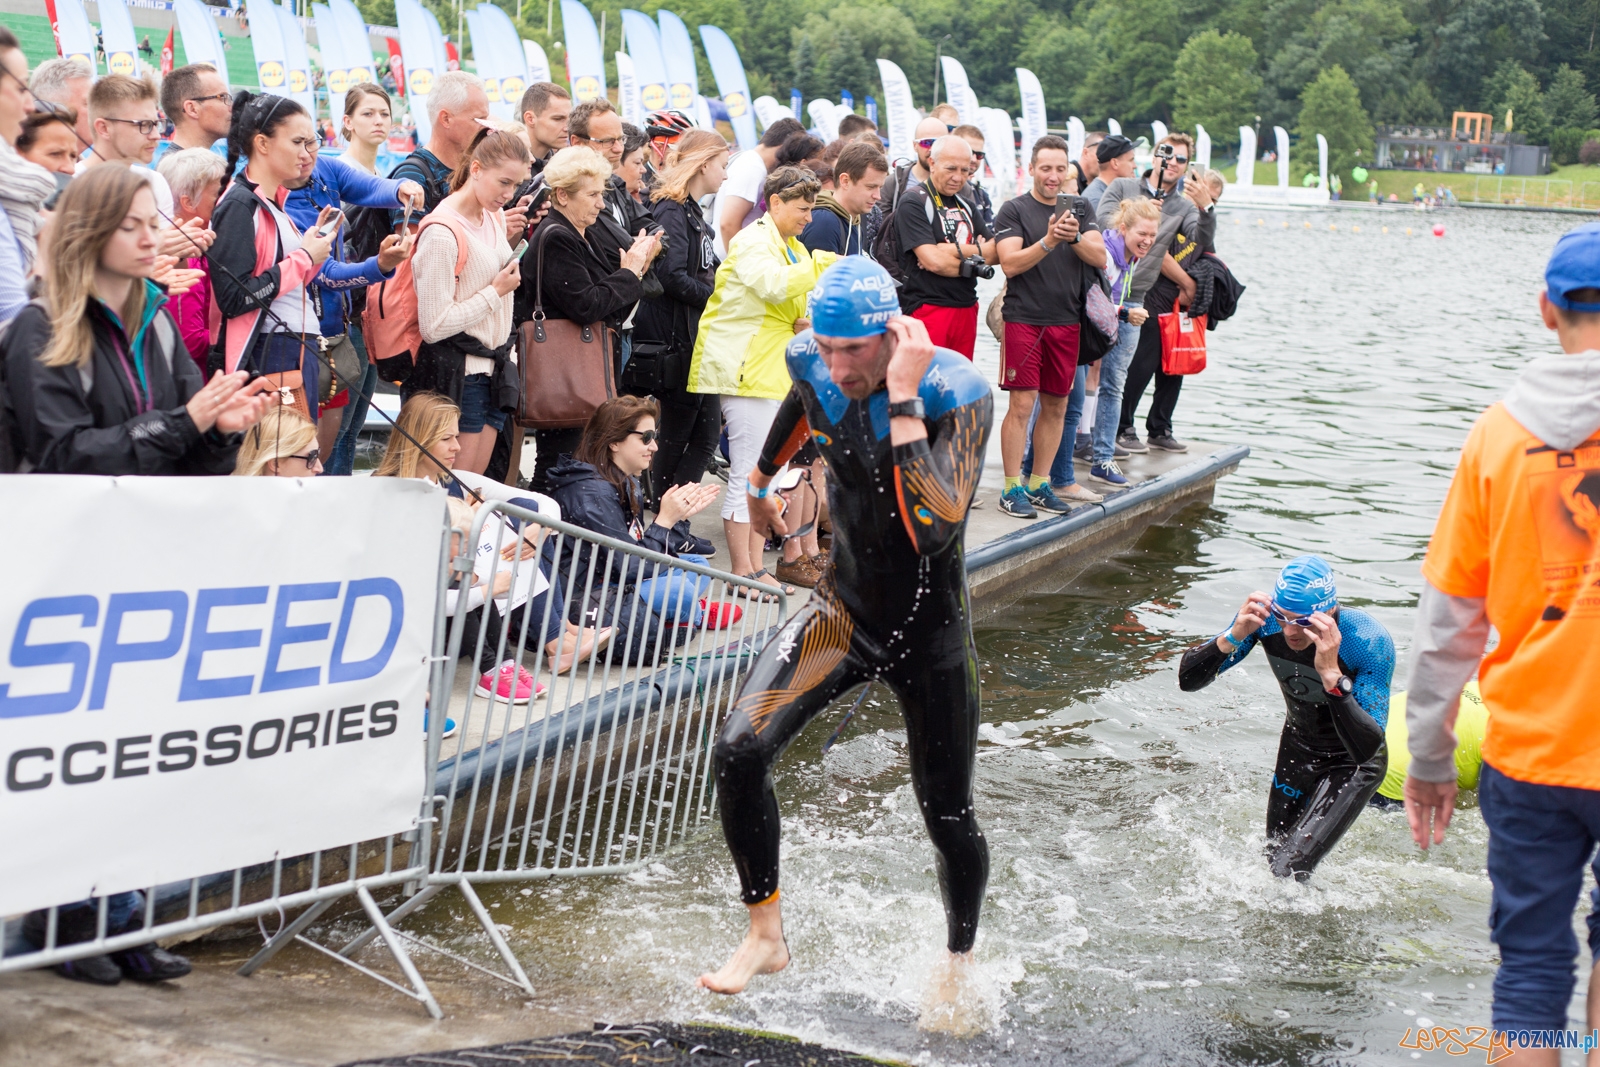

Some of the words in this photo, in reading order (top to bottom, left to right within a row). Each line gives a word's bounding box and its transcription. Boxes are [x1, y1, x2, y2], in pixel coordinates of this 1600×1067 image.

[0, 577, 404, 719] SPEED
[775, 621, 802, 663] helix
[6, 700, 400, 792] CCESSORIES
